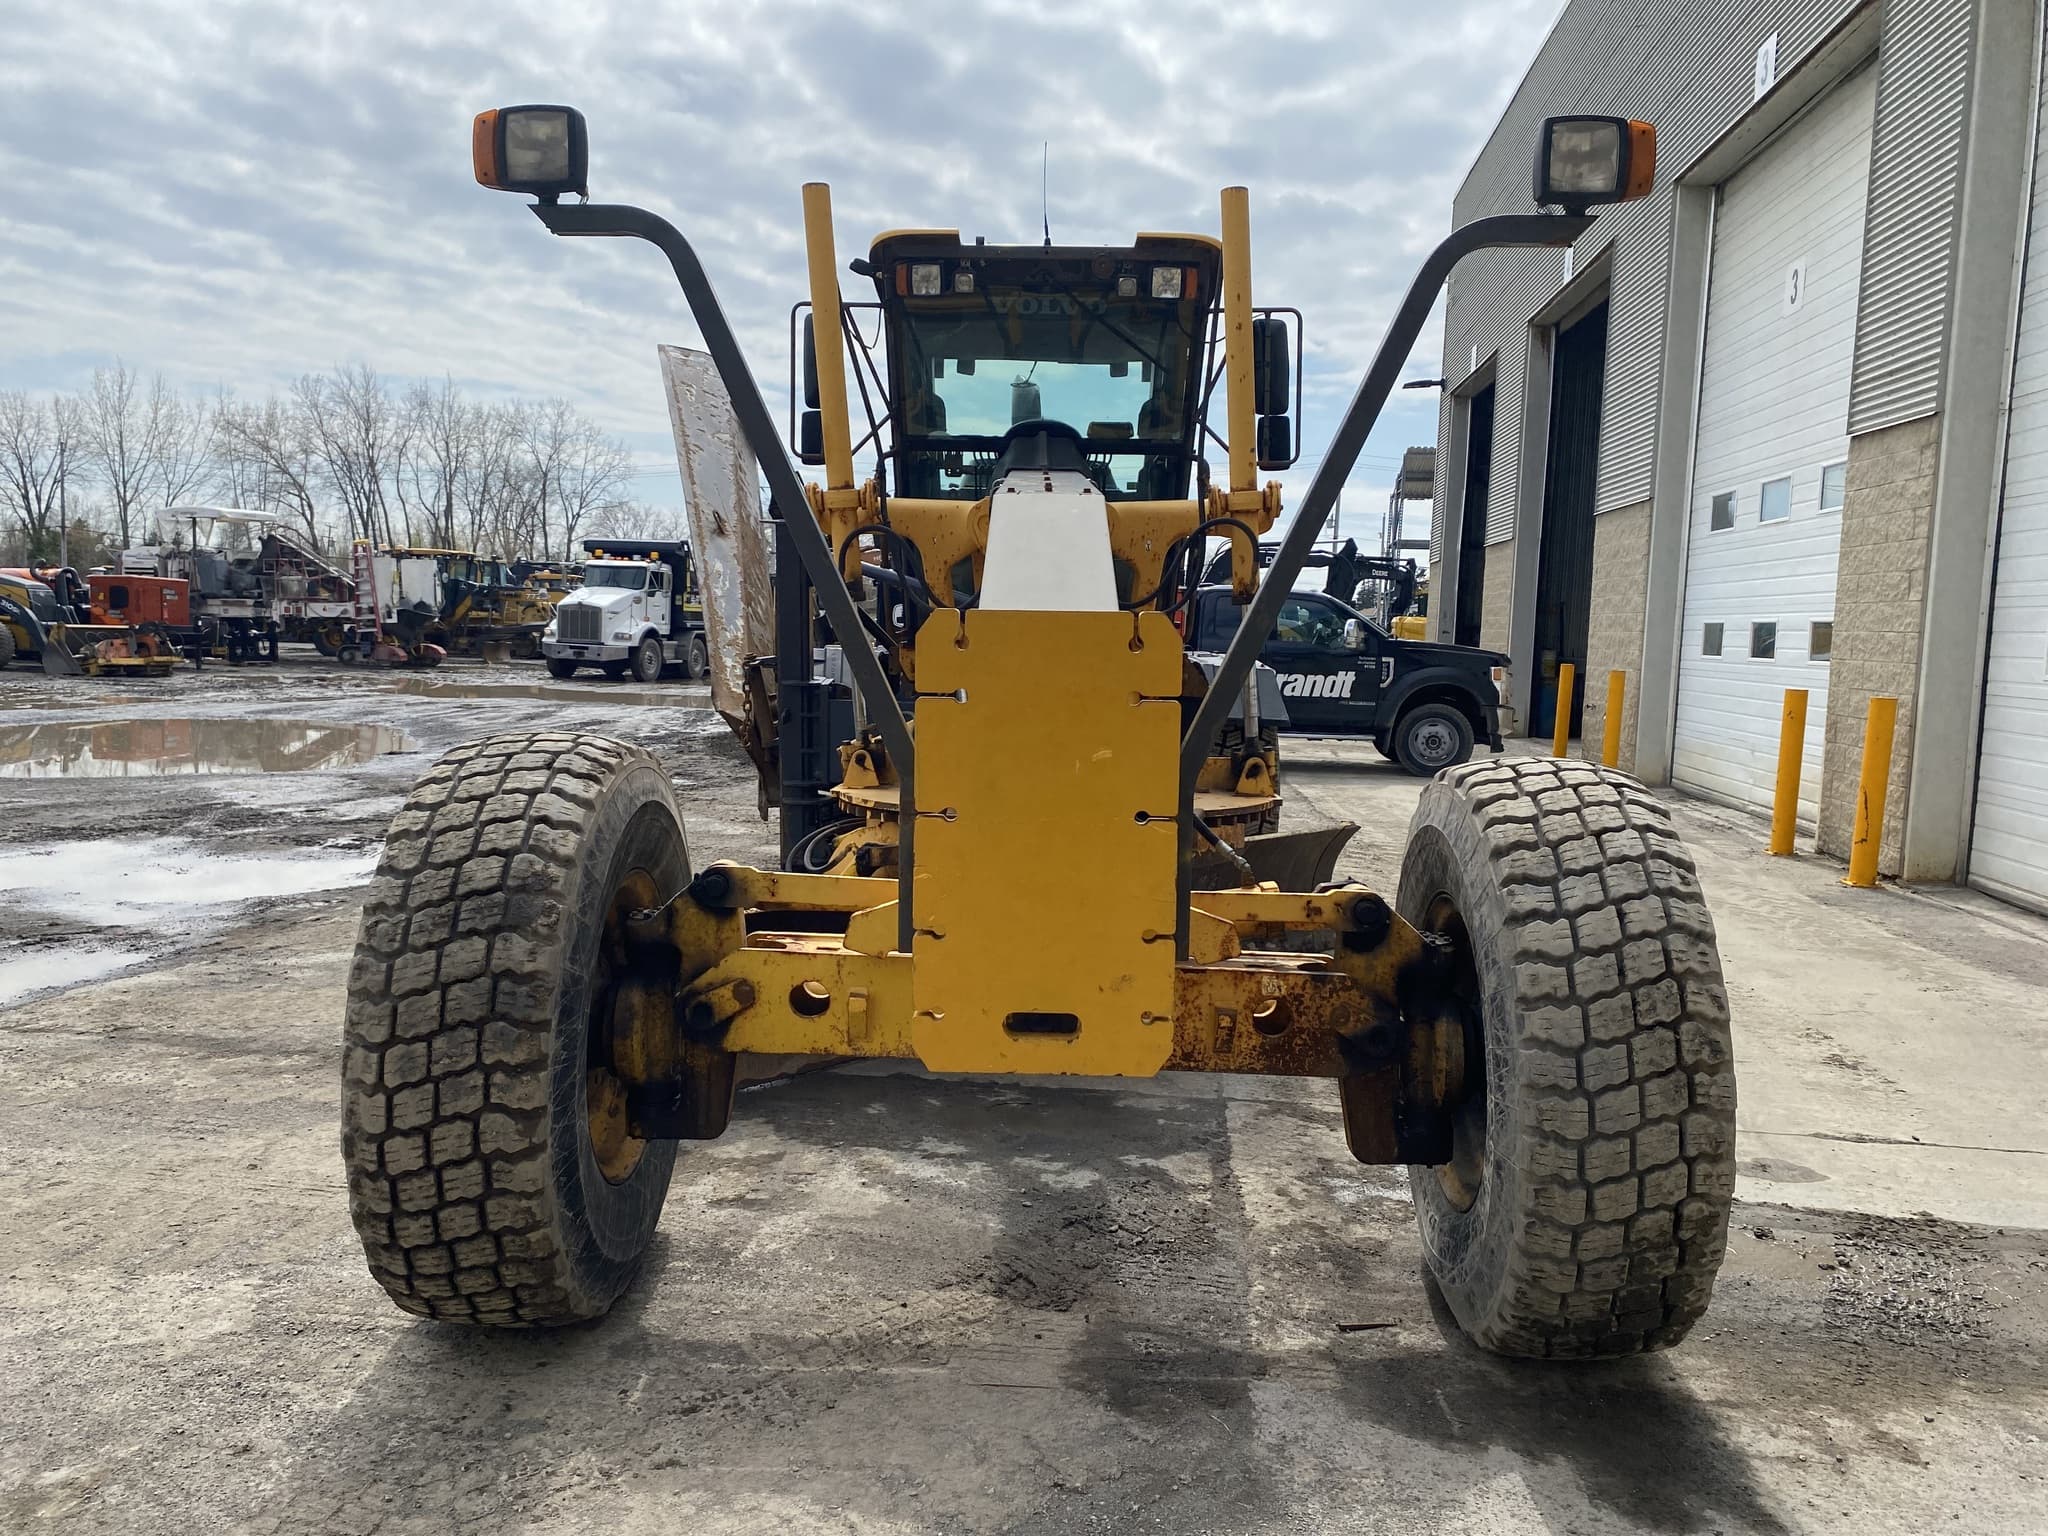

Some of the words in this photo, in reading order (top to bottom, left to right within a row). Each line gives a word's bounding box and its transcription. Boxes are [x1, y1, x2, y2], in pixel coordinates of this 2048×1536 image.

[1761, 48, 1769, 86] 3
[1790, 268, 1799, 305] 3
[1276, 671, 1356, 698] randt
